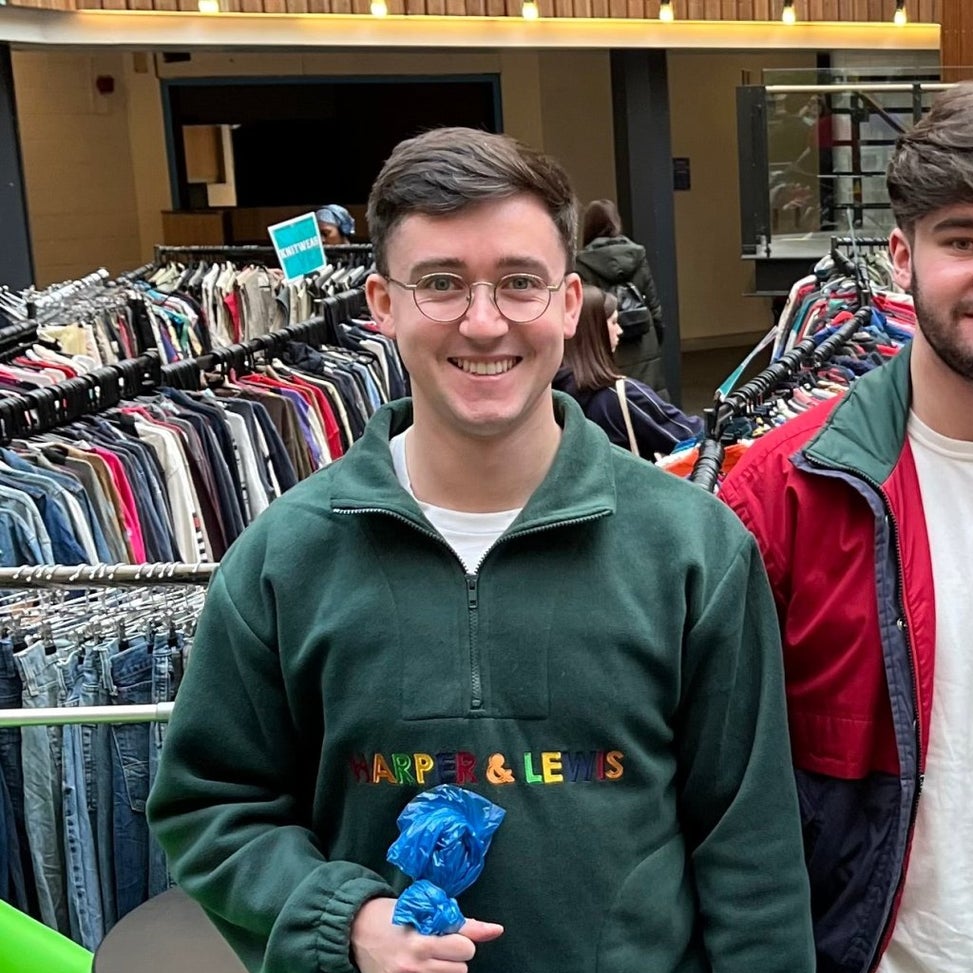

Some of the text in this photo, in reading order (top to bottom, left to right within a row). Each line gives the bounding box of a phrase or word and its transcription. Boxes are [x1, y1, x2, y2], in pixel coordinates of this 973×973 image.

[352, 751, 624, 785] HARPER & LEWIS
